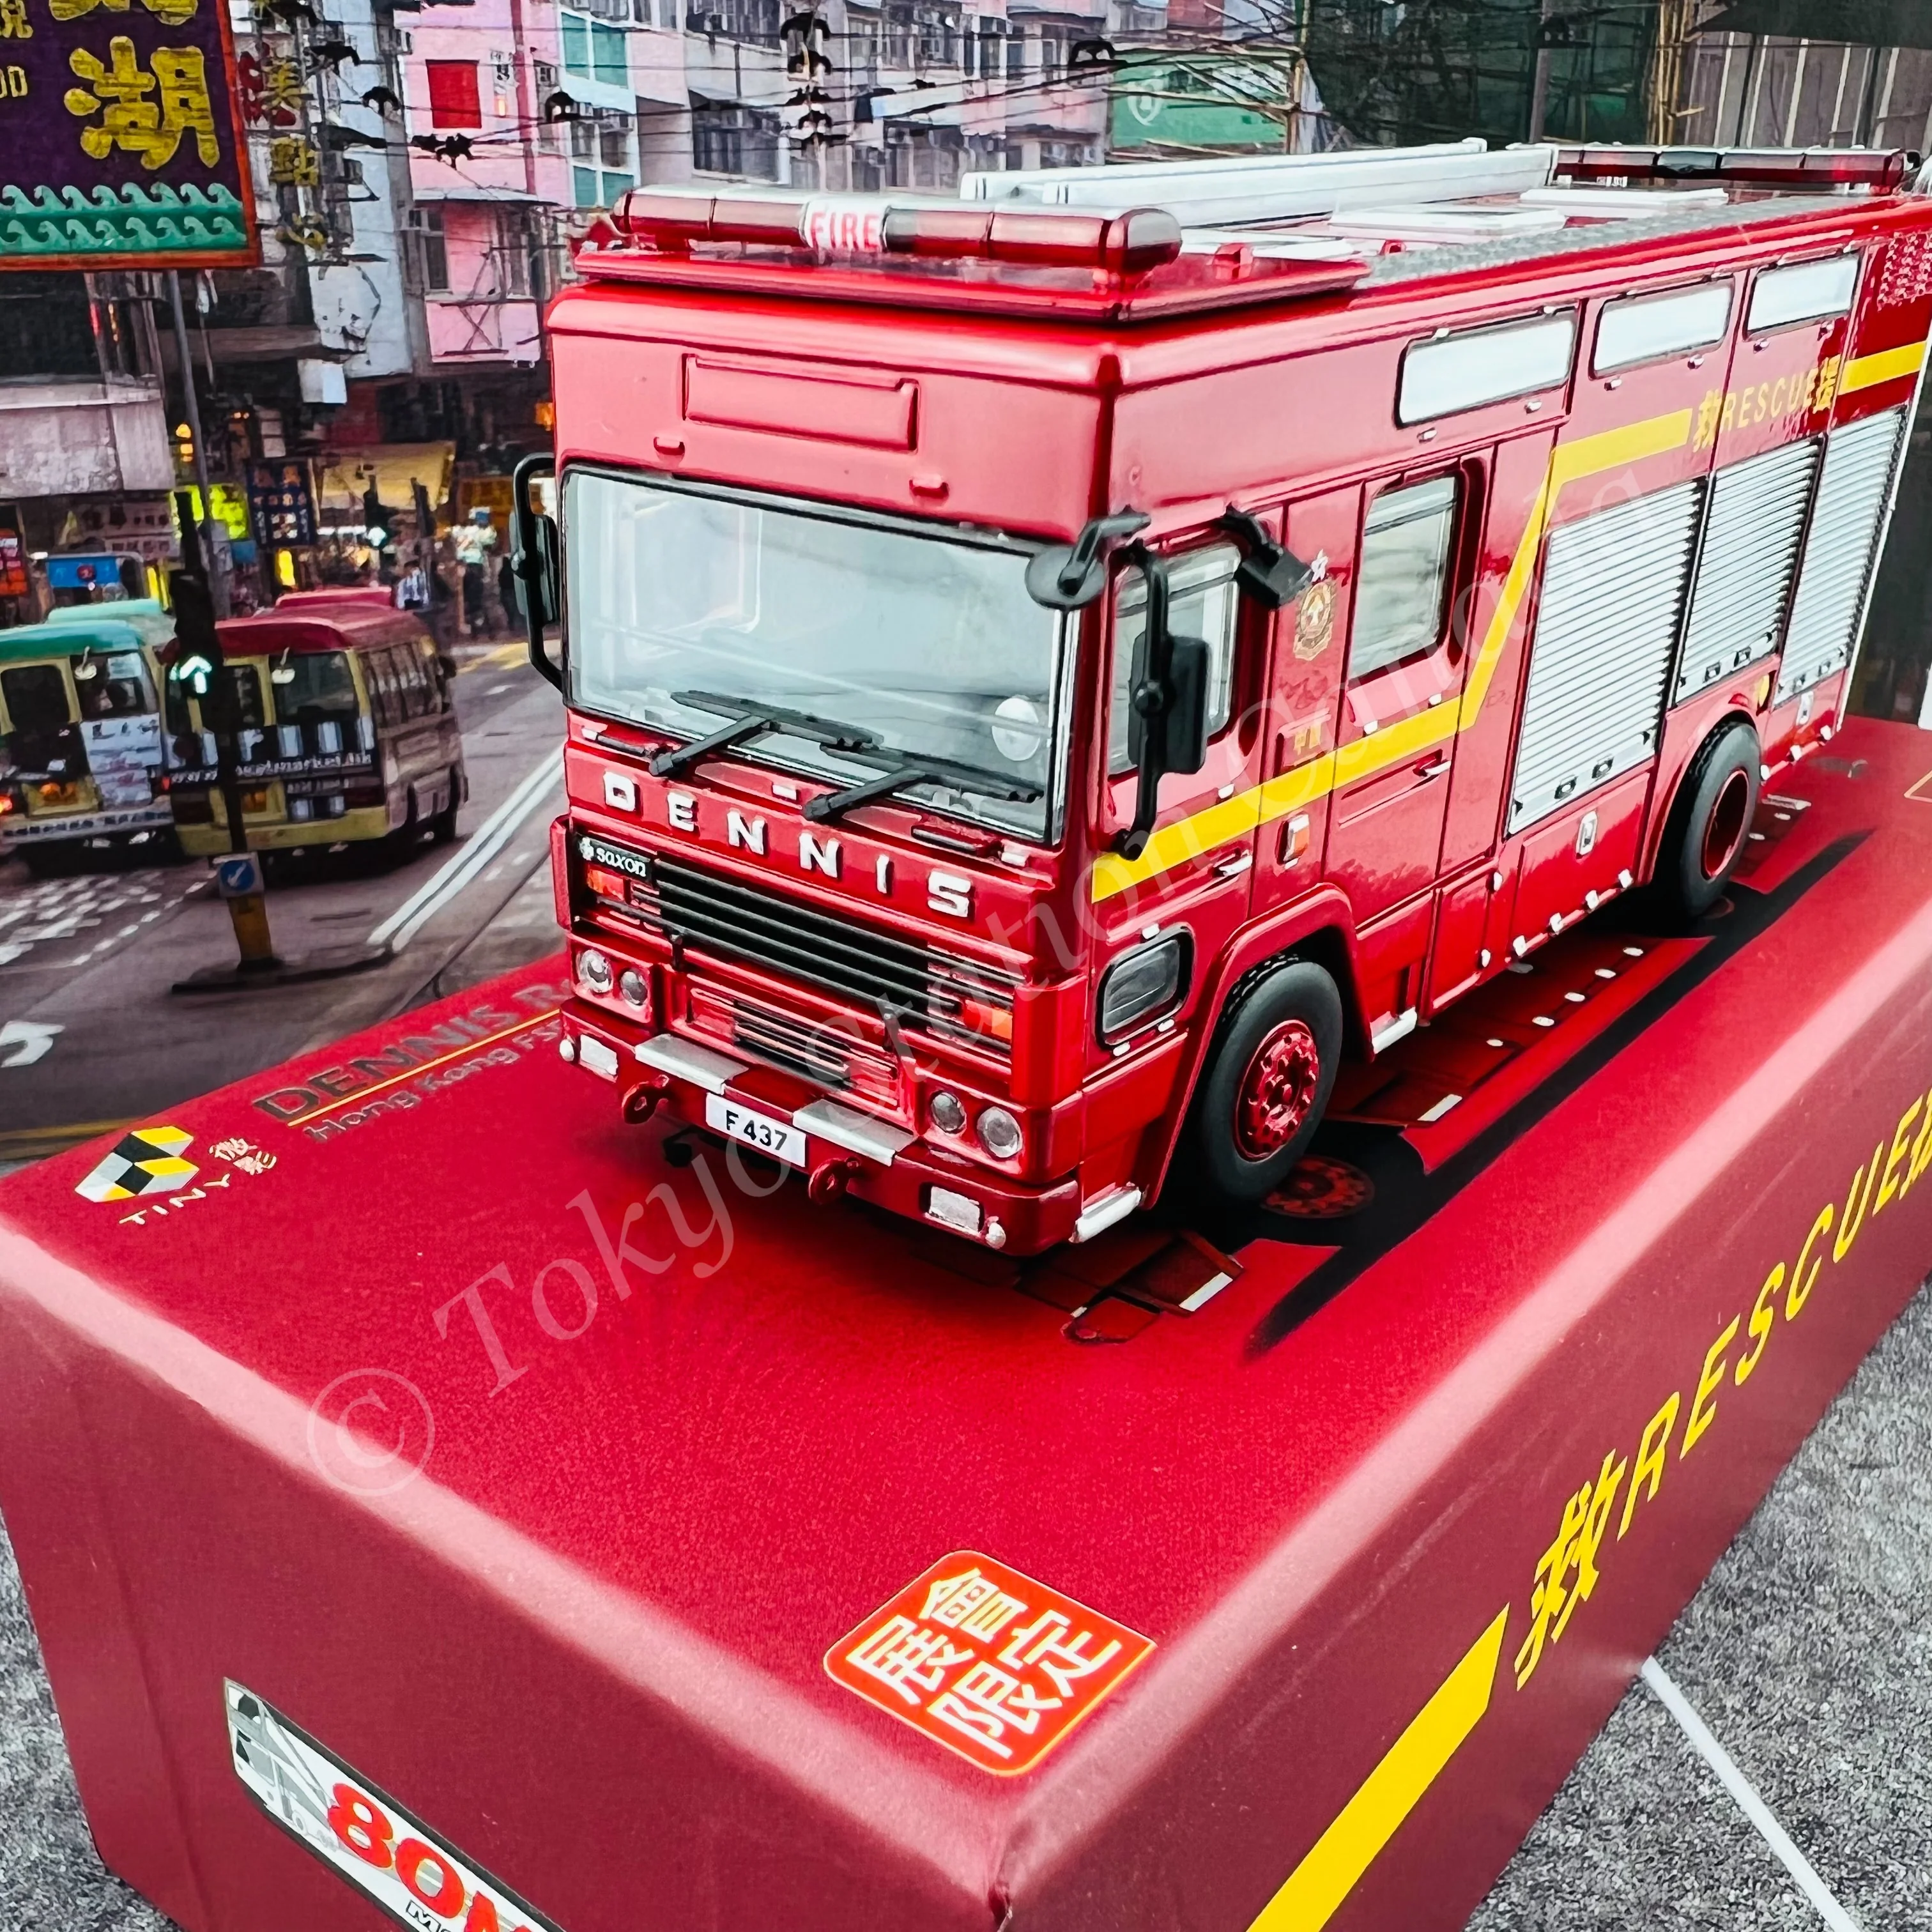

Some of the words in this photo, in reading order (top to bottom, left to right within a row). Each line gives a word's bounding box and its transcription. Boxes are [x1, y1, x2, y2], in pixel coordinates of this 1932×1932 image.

[50, 0, 220, 170] 湖
[810, 211, 880, 251] FIRE
[1719, 367, 1819, 434] RESCUE
[596, 847, 646, 877] saxon
[603, 770, 973, 918] DENNIS
[253, 1004, 519, 1121] DENNIS
[303, 1090, 422, 1143] Hong
[414, 1047, 520, 1091] Kong
[119, 1173, 231, 1225] TINY
[1617, 1093, 1923, 1542] RESCUE
